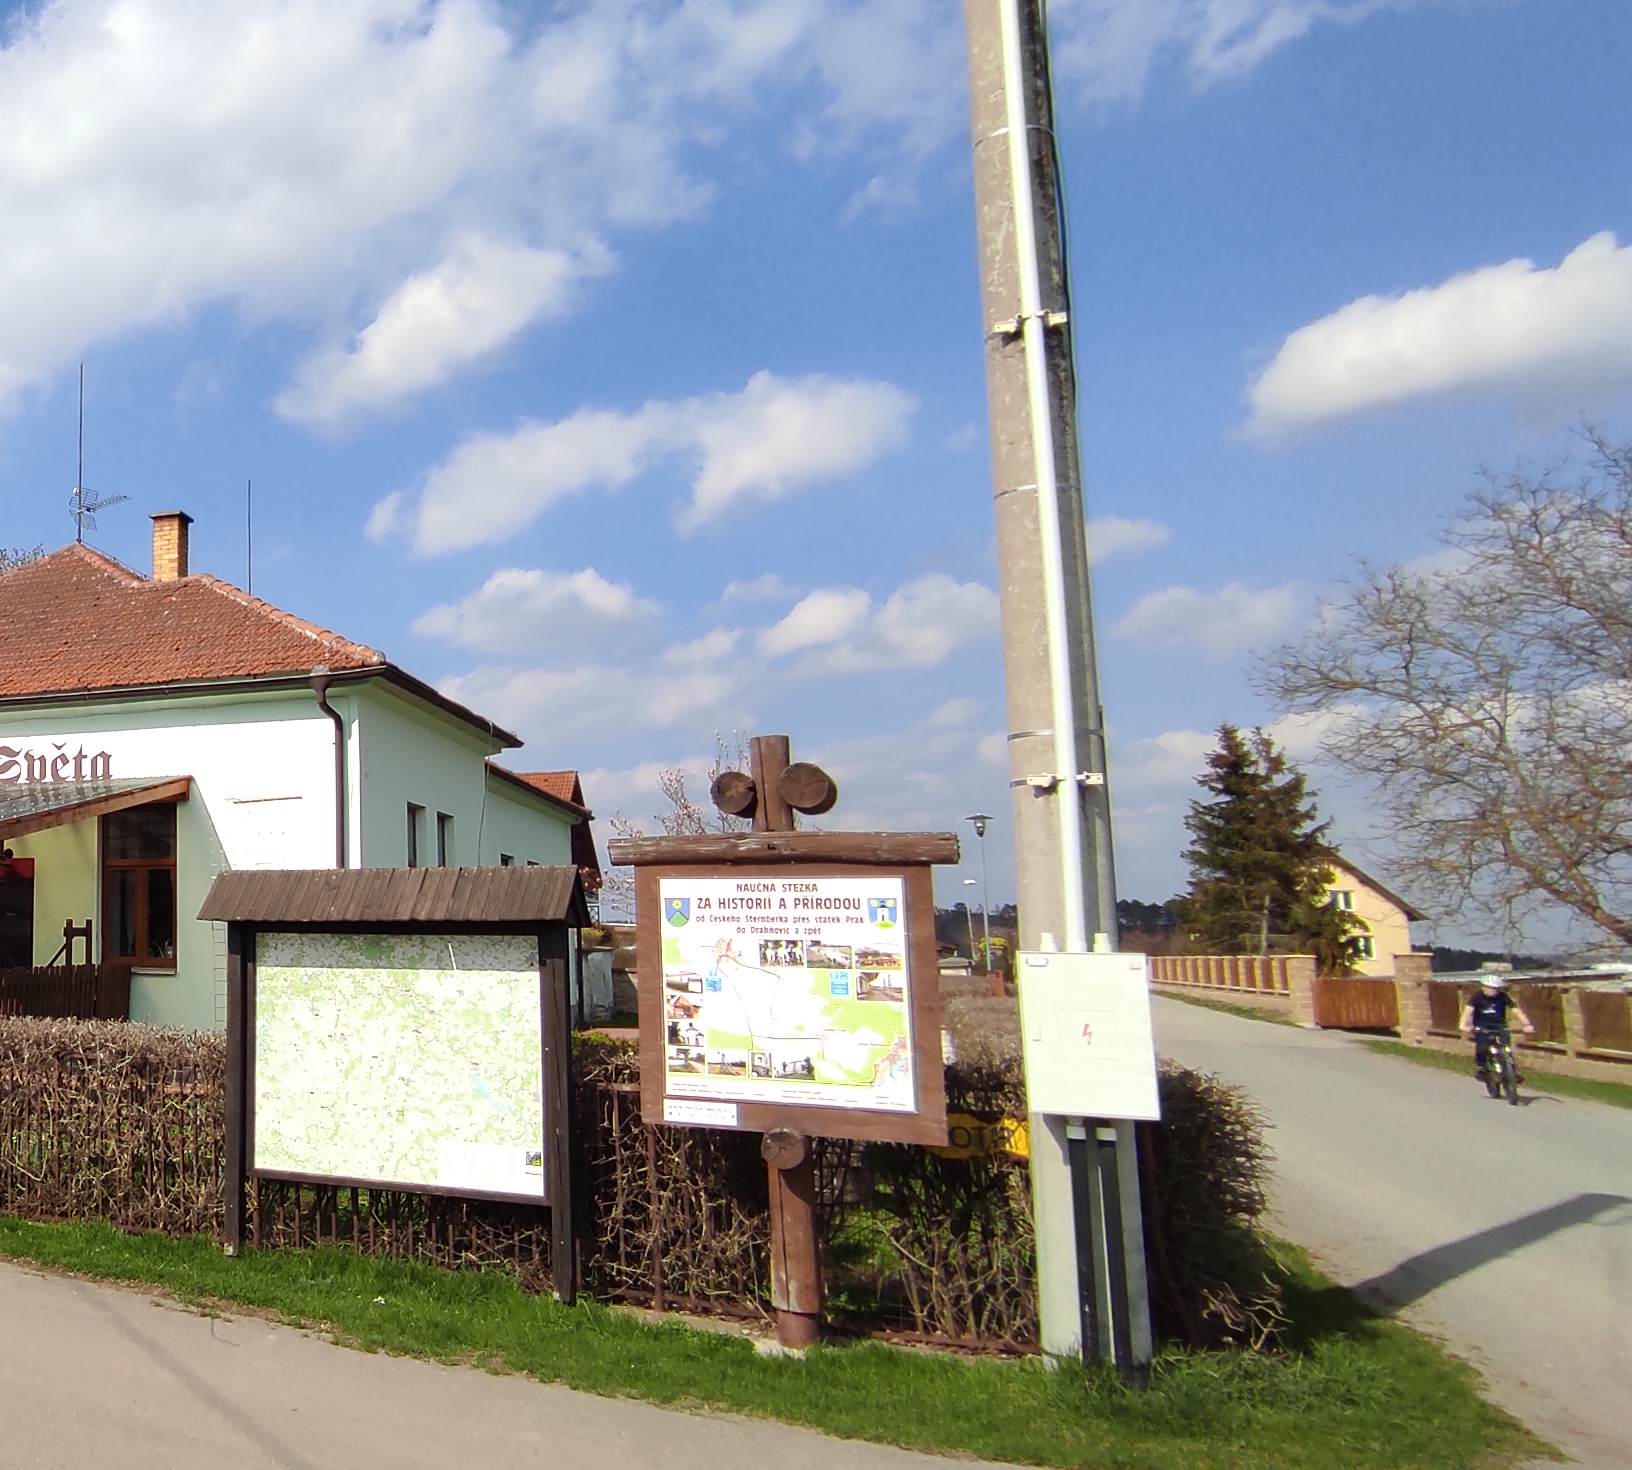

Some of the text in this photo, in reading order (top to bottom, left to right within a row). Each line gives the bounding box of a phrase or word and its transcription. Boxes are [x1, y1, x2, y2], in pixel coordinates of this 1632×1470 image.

[736, 882, 818, 893] NAUČNÁ STEZKA
[697, 897, 712, 910] ZA
[778, 897, 787, 910] A
[793, 894, 861, 910] PŘÍRODOU
[695, 915, 705, 923] od
[814, 916, 841, 924] statek
[845, 916, 865, 924] Prak
[736, 926, 746, 934] do
